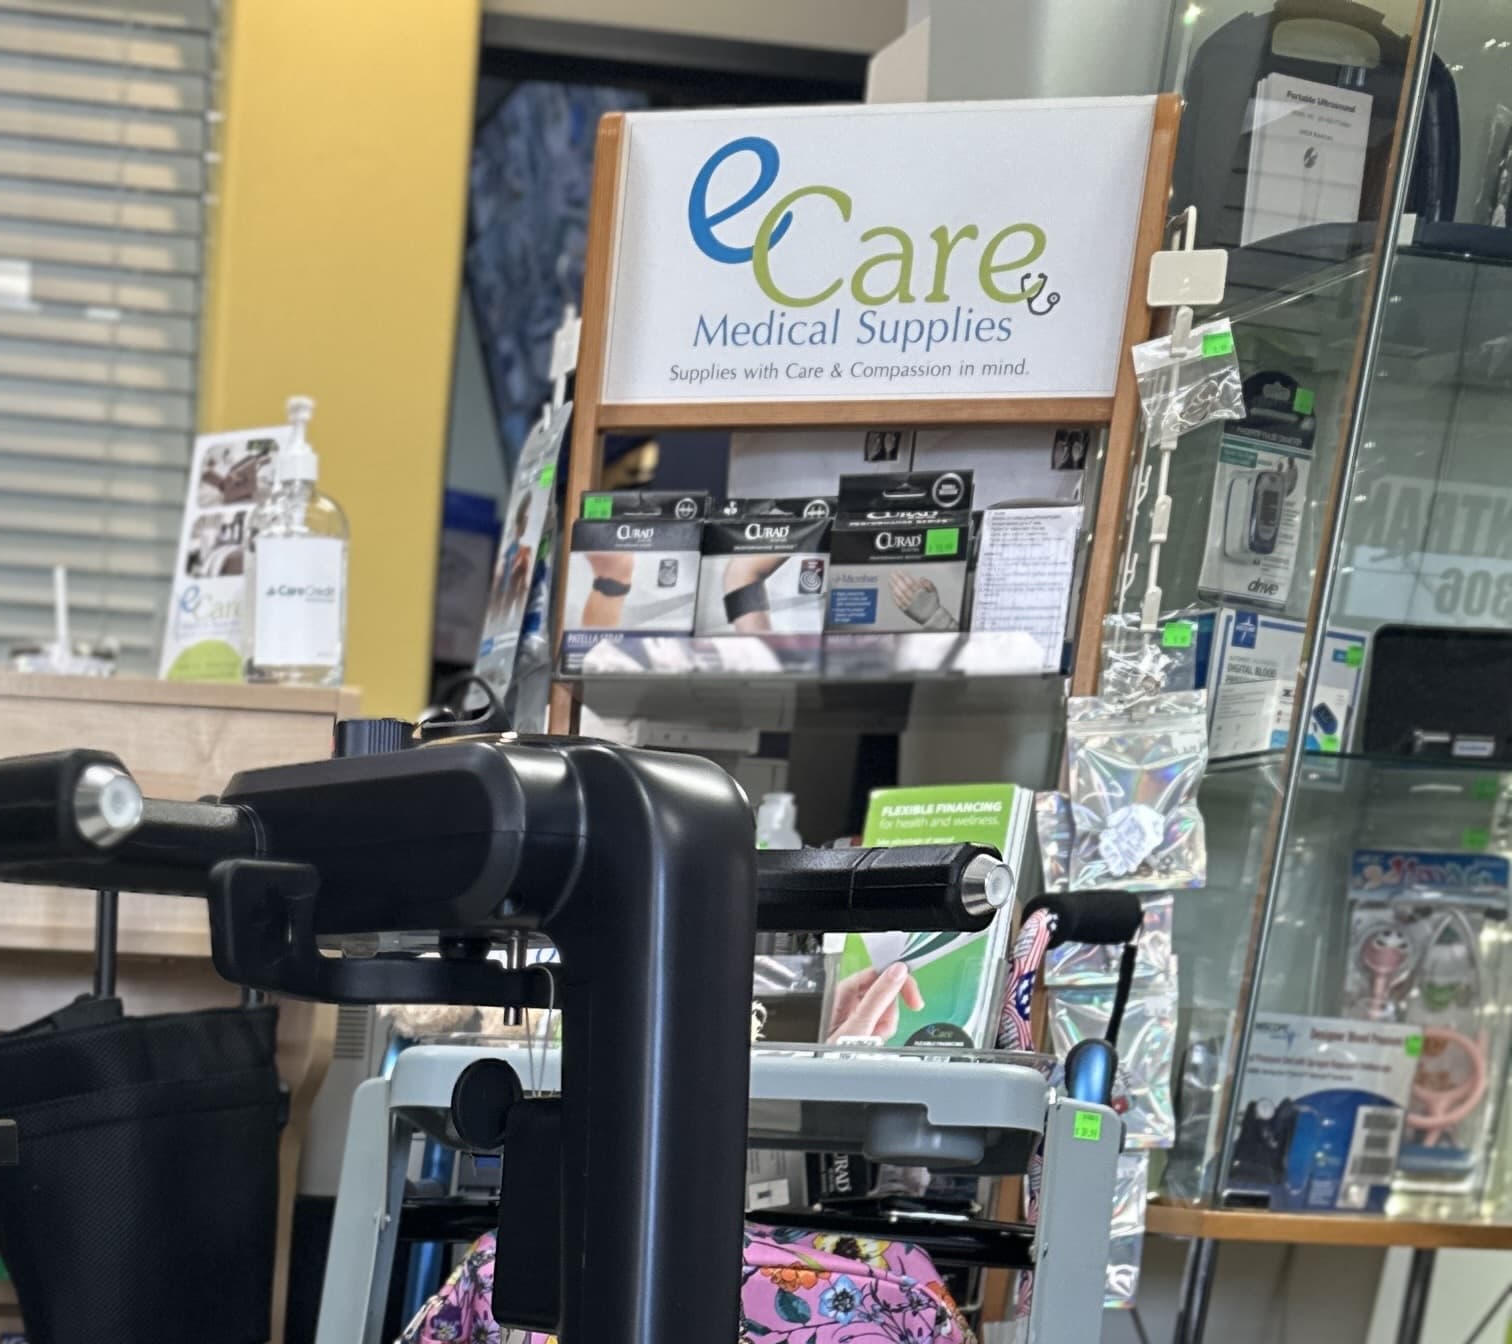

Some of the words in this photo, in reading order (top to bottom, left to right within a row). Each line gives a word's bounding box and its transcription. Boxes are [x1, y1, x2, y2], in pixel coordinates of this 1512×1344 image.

[688, 136, 1048, 308] eCare
[692, 308, 840, 347] Medical
[856, 309, 1013, 353] Supplies
[668, 362, 737, 383] Supplies
[743, 361, 780, 381] with
[784, 361, 824, 380] Care
[830, 361, 843, 379] &
[849, 359, 952, 382] Compassion
[958, 359, 974, 377] in
[981, 357, 1031, 377] mind.
[616, 524, 655, 540] CURAD
[744, 523, 790, 541] CURAD
[875, 531, 922, 550] CURAD
[278, 585, 335, 597] CareCredit
[1247, 576, 1280, 597] drive
[881, 802, 934, 817] FLEXIBLE
[936, 800, 1002, 814] FINANCING
[879, 817, 893, 829] for
[895, 816, 929, 829] health
[930, 816, 951, 828] and
[953, 815, 1000, 827] wellness.
